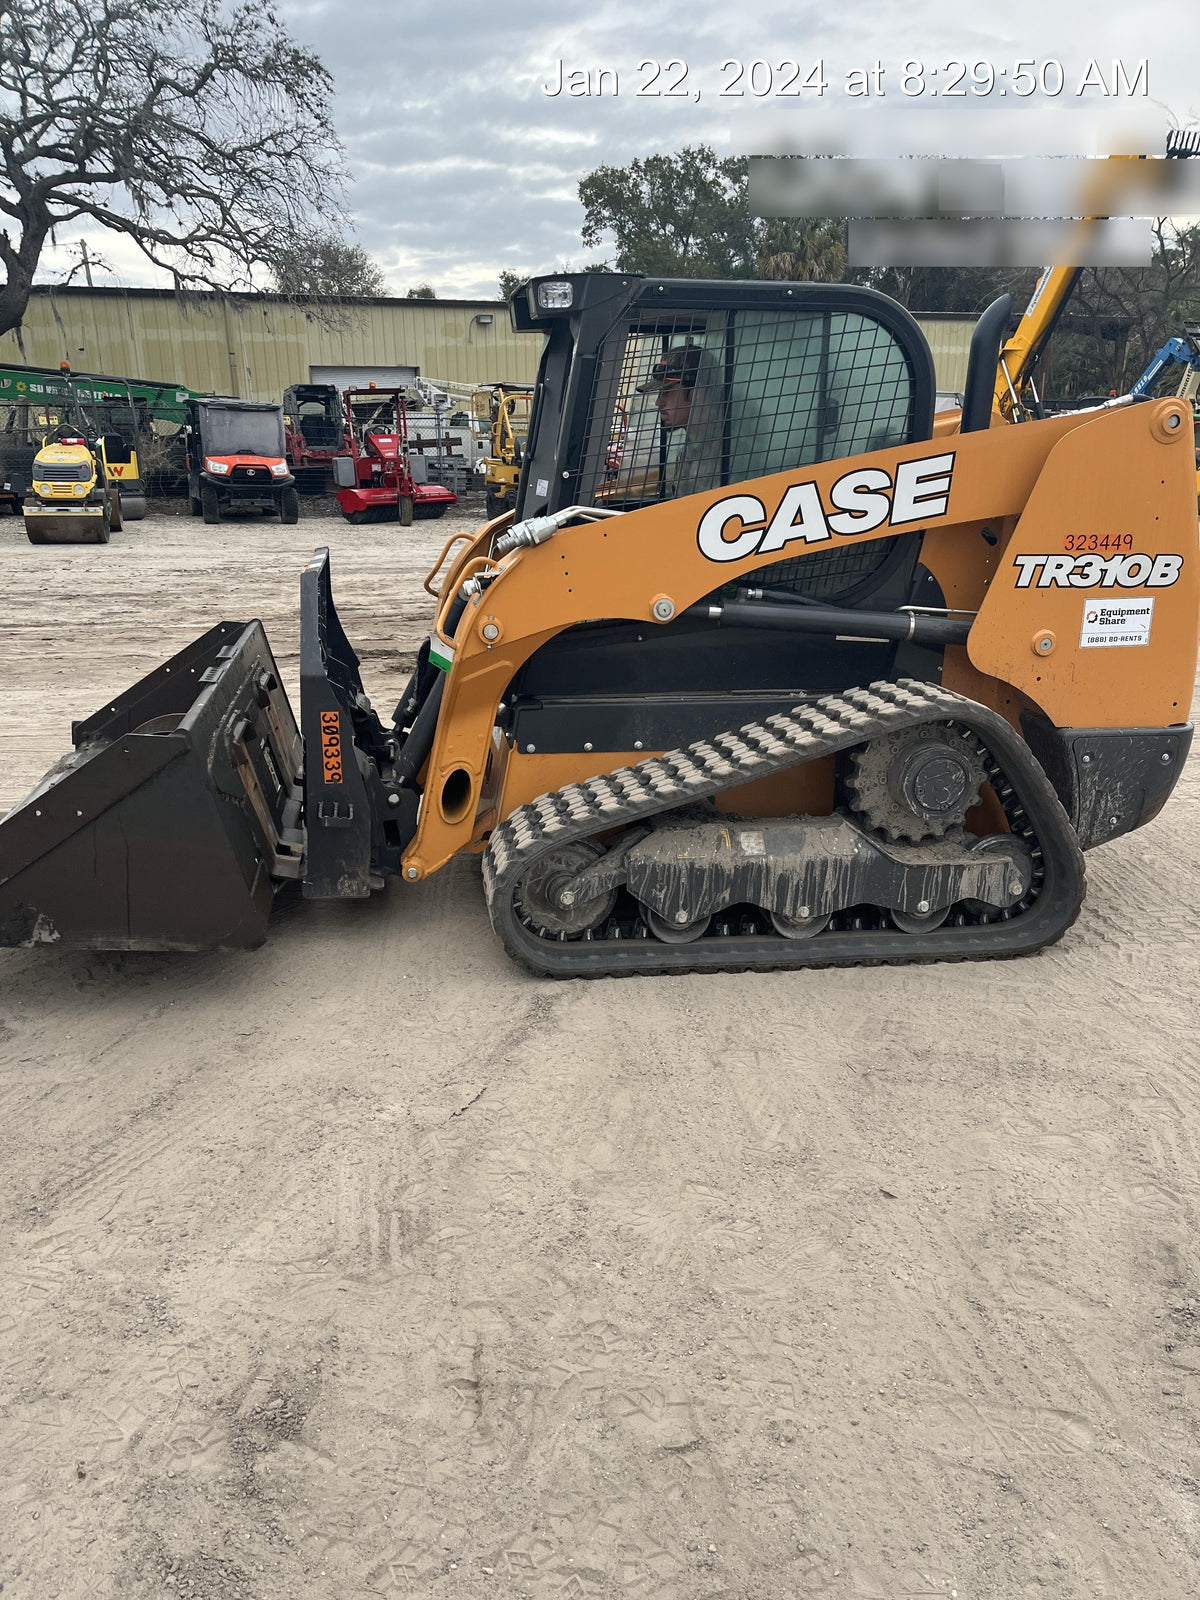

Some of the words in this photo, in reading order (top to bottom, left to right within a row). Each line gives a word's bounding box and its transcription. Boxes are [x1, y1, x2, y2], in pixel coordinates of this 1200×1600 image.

[697, 451, 956, 563] CASE
[1063, 534, 1133, 550] 323449
[1013, 553, 1184, 588] TR310B
[1099, 617, 1126, 625] Share
[1100, 607, 1150, 617] Equipment
[322, 713, 342, 783] 309339
